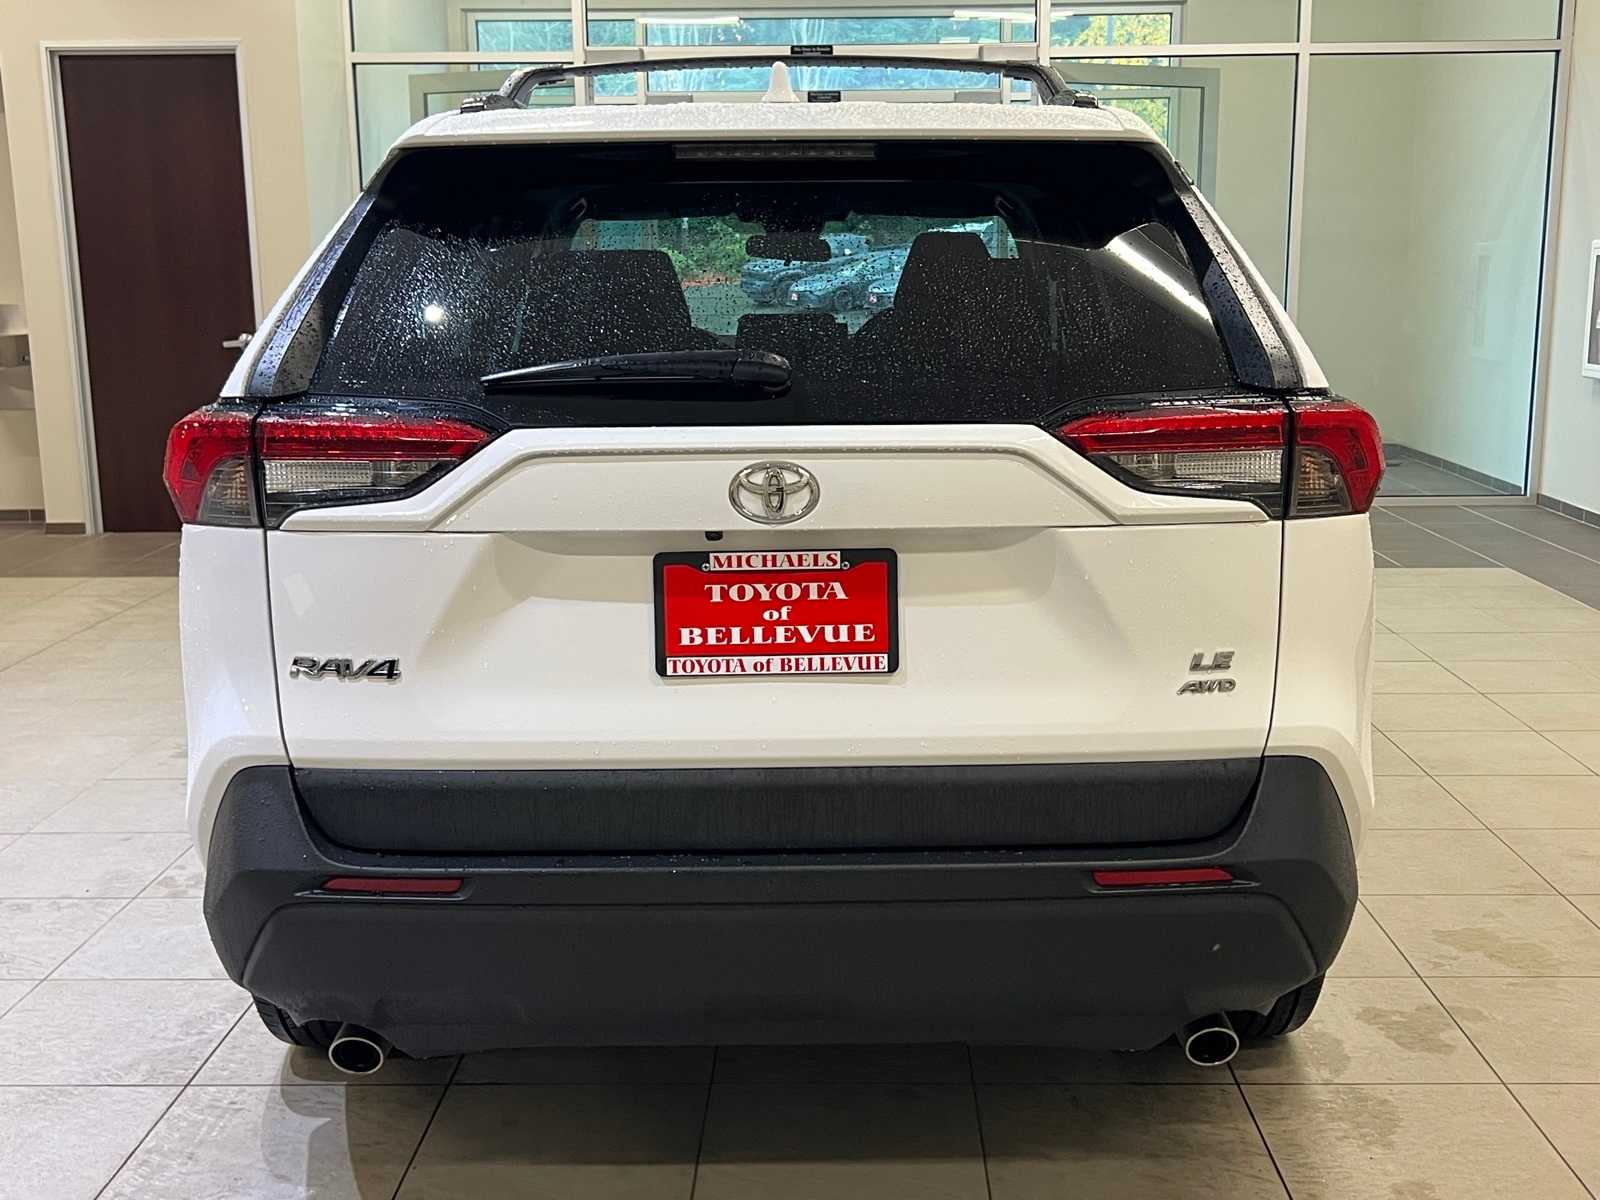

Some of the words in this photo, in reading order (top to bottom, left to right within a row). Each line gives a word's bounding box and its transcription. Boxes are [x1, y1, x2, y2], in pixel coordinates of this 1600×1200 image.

[712, 552, 839, 569] MICHAELS
[704, 581, 848, 602] TOYOTA
[763, 606, 792, 621] of
[678, 623, 876, 646] BELLEVUE
[290, 656, 401, 684] RAV4
[668, 657, 747, 674] TOYOTA
[753, 658, 774, 673] of
[780, 655, 886, 673] BELLEVUE
[1189, 651, 1235, 671] LE
[1176, 678, 1237, 696] AWD
